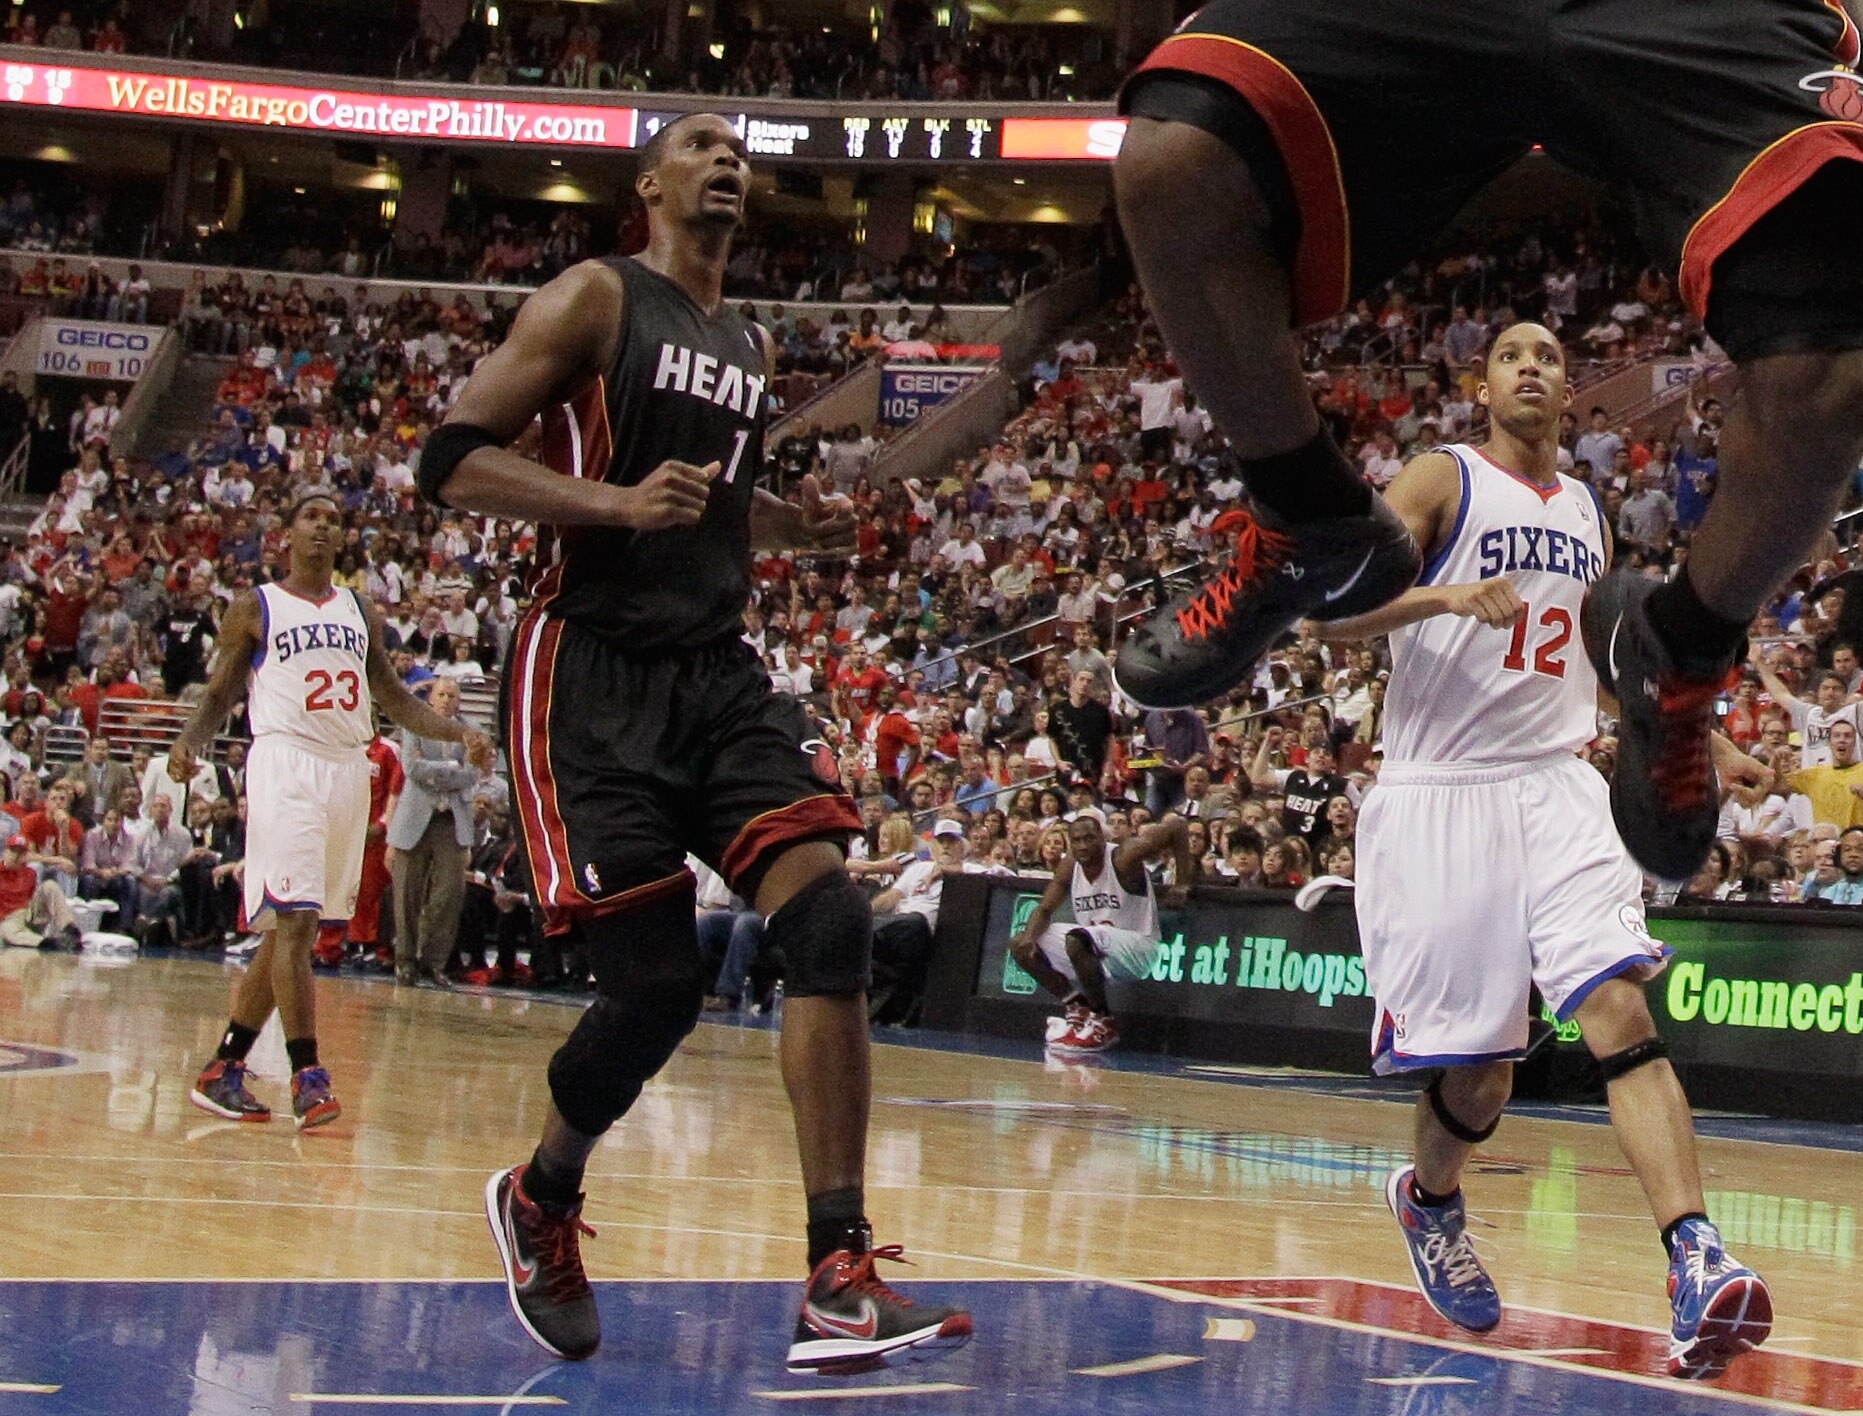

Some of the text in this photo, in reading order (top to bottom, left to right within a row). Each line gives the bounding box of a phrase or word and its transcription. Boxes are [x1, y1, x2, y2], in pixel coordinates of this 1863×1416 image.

[106, 74, 606, 143] WellsFargoCenterPhilly.com
[43, 351, 81, 372] 106
[57, 328, 150, 352] GEICO
[653, 342, 767, 420] HEAT
[883, 397, 920, 420] 105
[723, 429, 751, 484] 1
[274, 622, 367, 664] SIXERS
[1502, 600, 1574, 679] 12
[304, 668, 362, 712] 23
[1190, 935, 1231, 985] at
